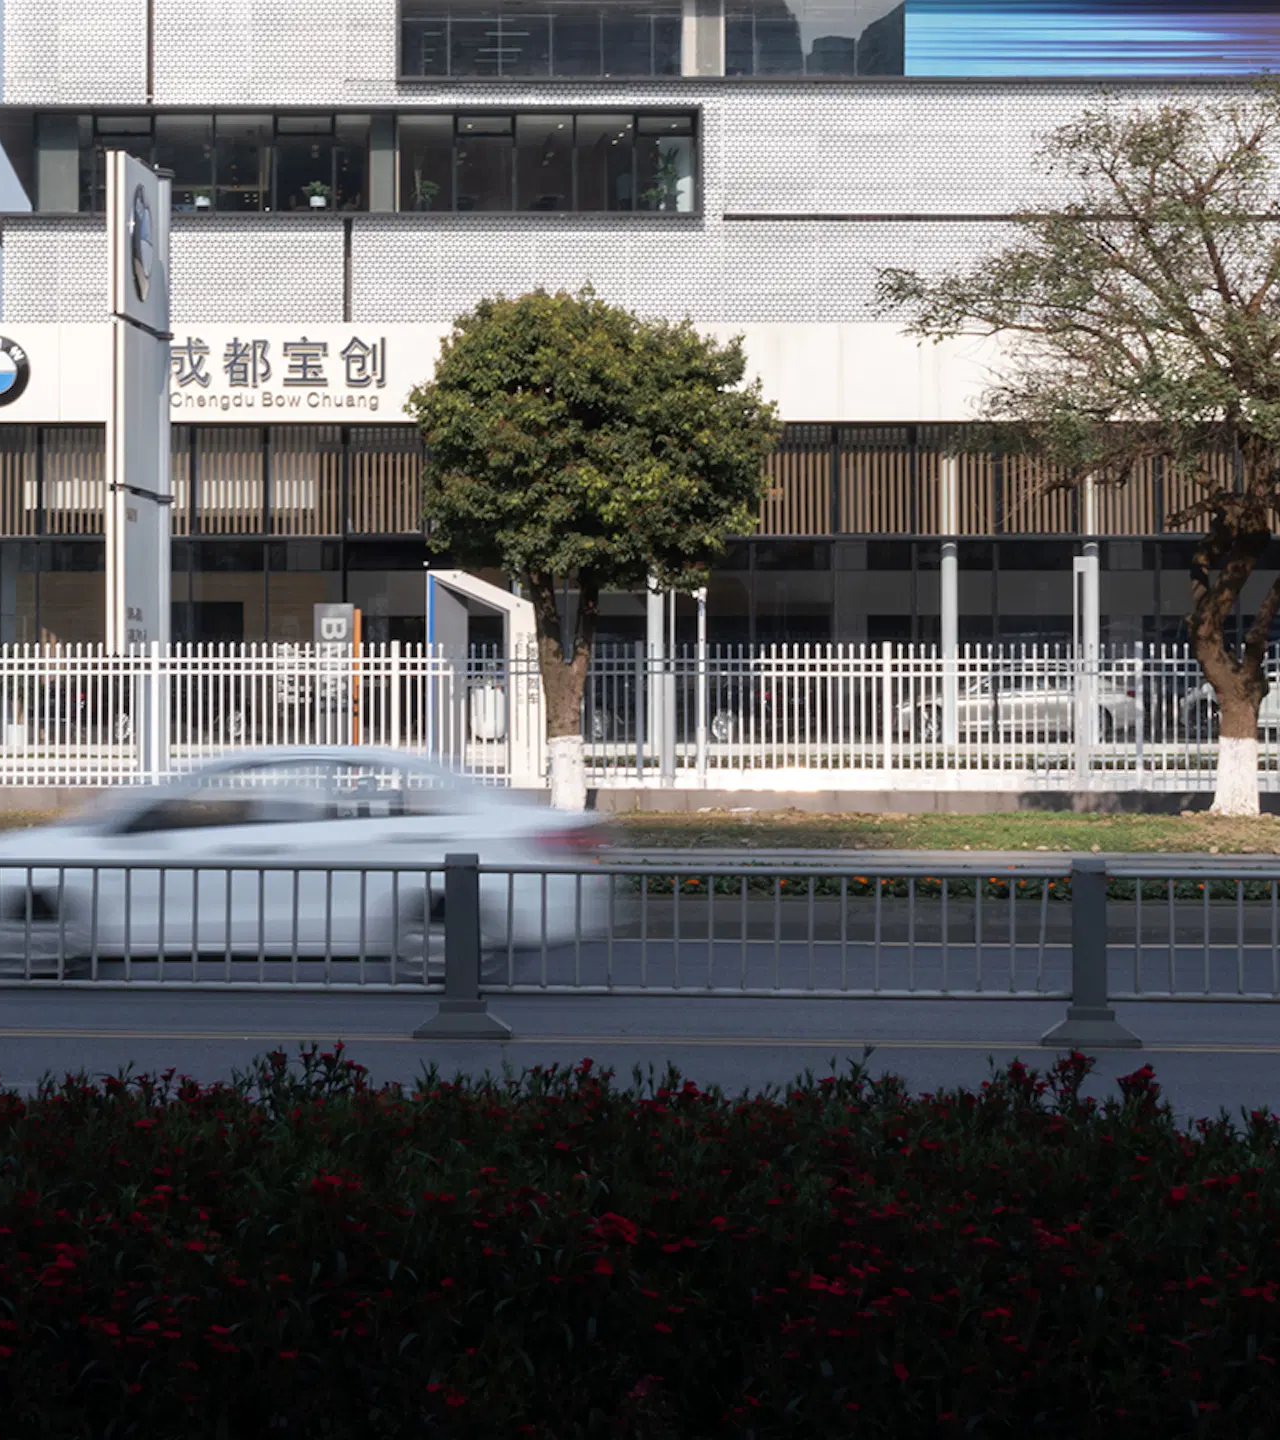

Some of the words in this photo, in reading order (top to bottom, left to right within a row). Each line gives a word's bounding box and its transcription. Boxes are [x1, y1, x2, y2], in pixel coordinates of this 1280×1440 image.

[170, 336, 387, 389] 成都宝创
[170, 391, 255, 411] Chengdu
[262, 391, 302, 408] Bow
[306, 391, 380, 411] Chuang
